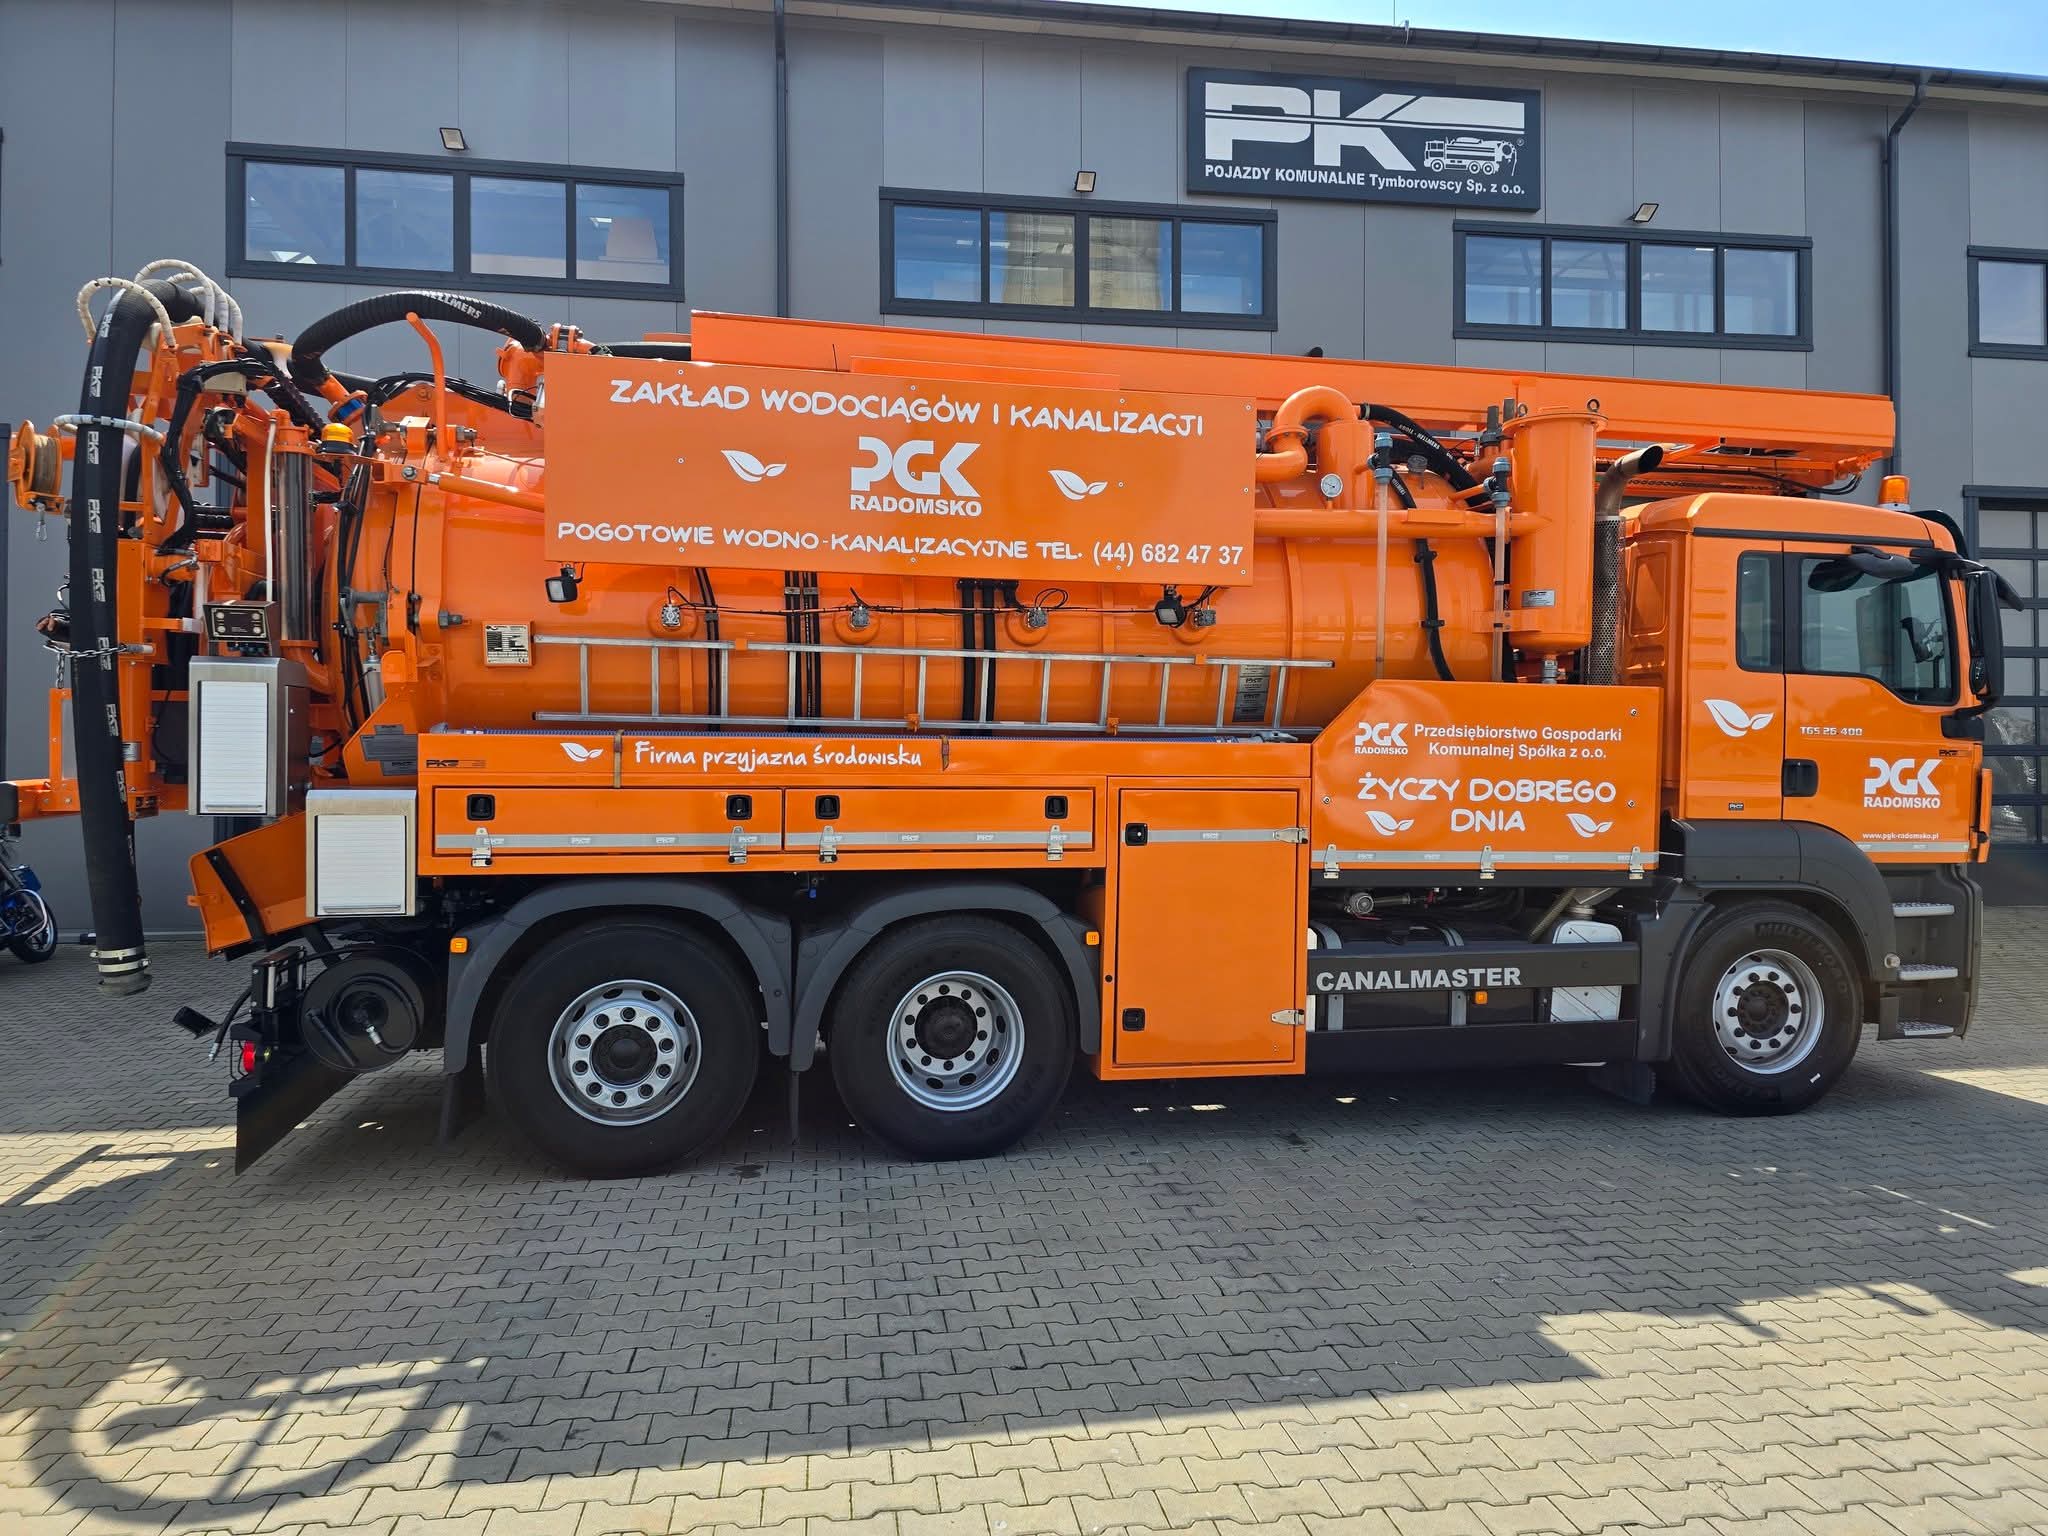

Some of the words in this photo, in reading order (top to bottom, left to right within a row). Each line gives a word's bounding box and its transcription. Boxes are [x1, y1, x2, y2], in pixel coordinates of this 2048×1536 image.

[1205, 164, 1271, 181] POJAZDY
[1275, 168, 1365, 186] KOMUNALNE
[1369, 173, 1463, 194] Tymborowscy
[1466, 178, 1487, 194] Sp.
[1490, 184, 1498, 193] z
[1501, 183, 1525, 195] o.o.
[610, 380, 749, 409] ZAKŁAD
[761, 389, 981, 424] WODOCIĄGÓW
[992, 403, 1000, 425] I
[1010, 404, 1203, 437] KANALIZACJI
[851, 436, 981, 498] PGK
[850, 494, 982, 517] RADOMSKO
[558, 523, 715, 545] POGOTOWIE
[723, 530, 1029, 559] WODNO-KANALIZACYJNE
[1036, 541, 1083, 560] TEL.
[1093, 542, 1134, 566] (44)
[1141, 544, 1180, 564] 682
[1185, 545, 1212, 564] 47
[1218, 546, 1244, 565] 37
[1355, 722, 1408, 746] PGK
[1414, 723, 1538, 741] Przedsiębiorstwo
[1541, 726, 1622, 743] Gospodarki
[634, 741, 696, 764] Firma
[702, 748, 808, 773] przyjazna
[812, 743, 922, 765] środowisku
[1354, 746, 1408, 755] RADOMSKO
[1428, 742, 1515, 760] Komunalnej
[1518, 743, 1566, 759] Spółka
[1570, 748, 1577, 758] z
[1580, 748, 1607, 759] o.o.
[1358, 771, 1461, 801] ŻYCZY
[1469, 778, 1617, 804] DOBREGO
[1864, 757, 1942, 795] PGK
[1863, 796, 1941, 809] RADOMSKO
[1451, 809, 1526, 832] DNIA
[1862, 832, 1940, 841] www.pgk-radomsko.pl
[1316, 967, 1521, 992] CANALMASTER
